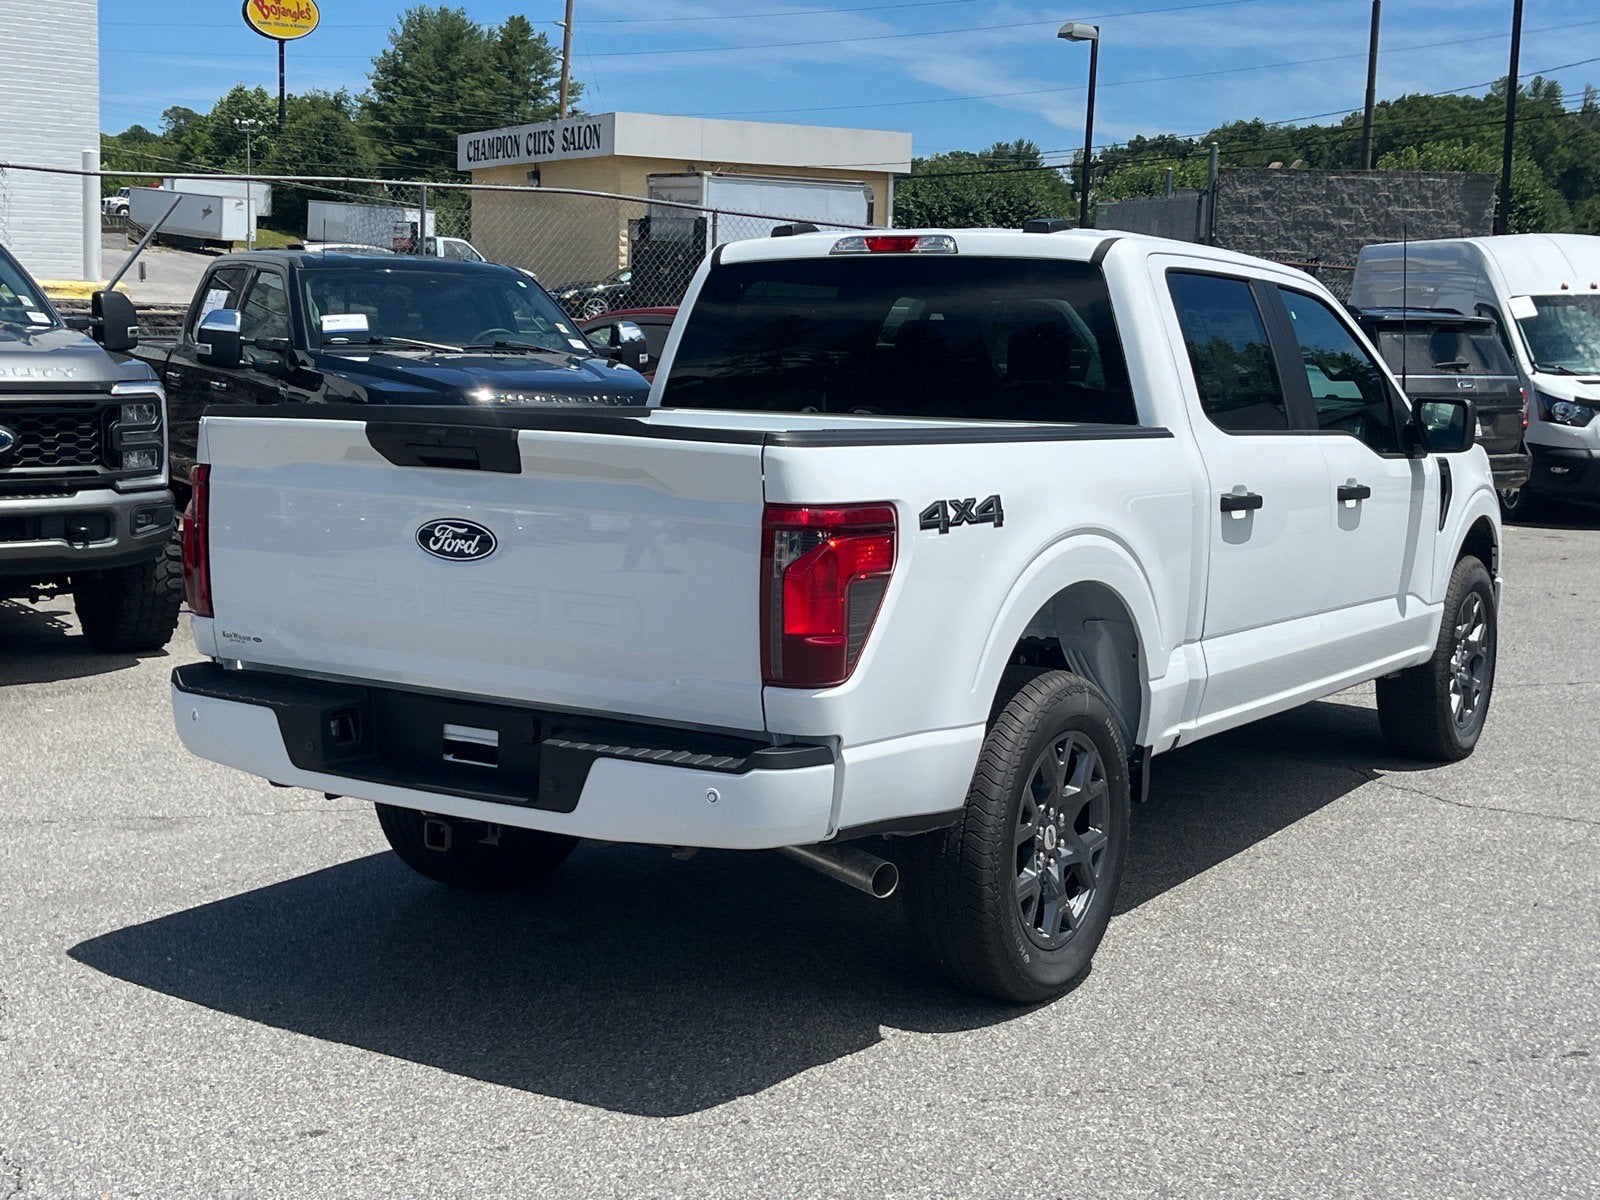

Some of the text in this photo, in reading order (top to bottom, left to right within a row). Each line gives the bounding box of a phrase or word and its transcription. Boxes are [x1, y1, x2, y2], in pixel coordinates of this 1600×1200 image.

[467, 123, 602, 163] CHAMPION CUTS SALON
[429, 524, 481, 555] Ford
